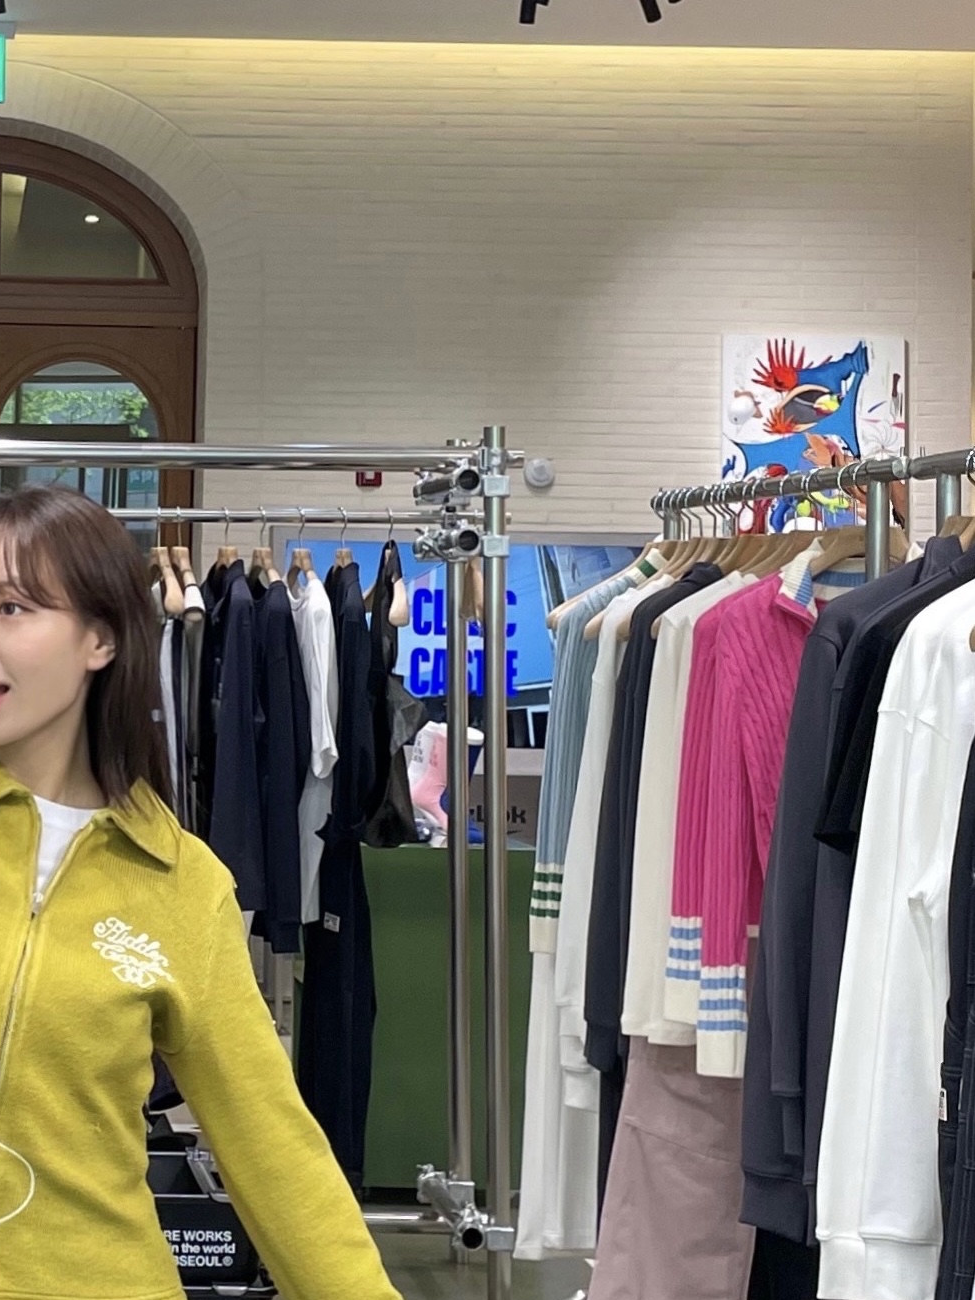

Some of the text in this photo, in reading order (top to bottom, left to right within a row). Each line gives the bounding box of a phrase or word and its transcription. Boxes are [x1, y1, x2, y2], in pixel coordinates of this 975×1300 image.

[410, 647, 518, 696] CATE
[183, 1230, 233, 1242] WORKS
[181, 1243, 200, 1254] the
[202, 1243, 236, 1254] world
